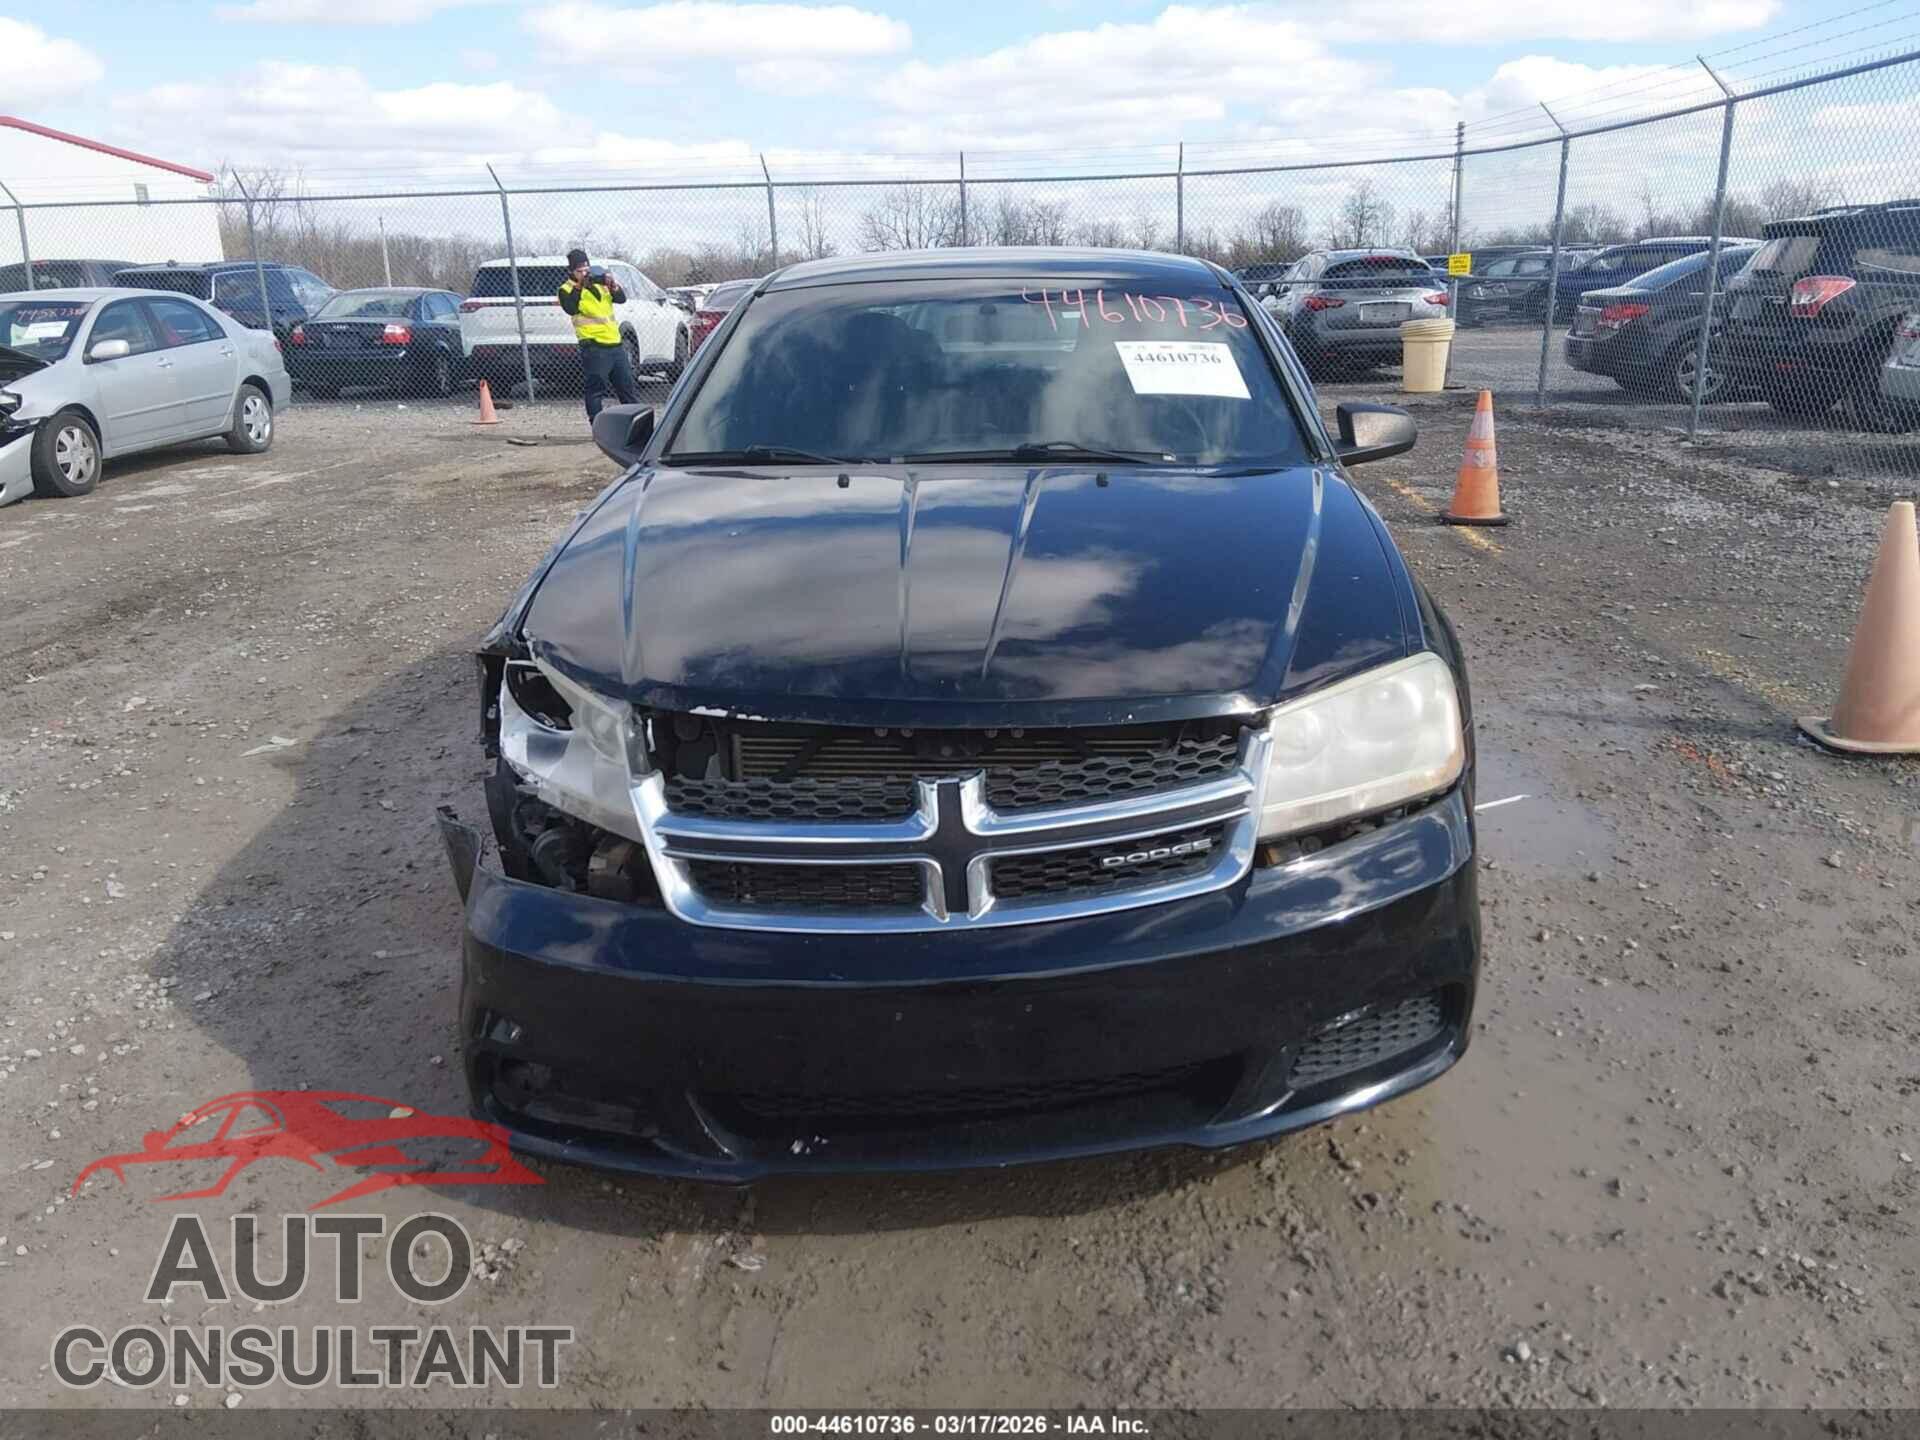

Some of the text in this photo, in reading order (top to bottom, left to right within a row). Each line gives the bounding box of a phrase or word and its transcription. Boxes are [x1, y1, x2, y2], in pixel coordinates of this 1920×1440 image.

[1021, 286, 1248, 332] 44610736
[1133, 352, 1222, 365] 44610736
[1102, 838, 1213, 867] DODGE
